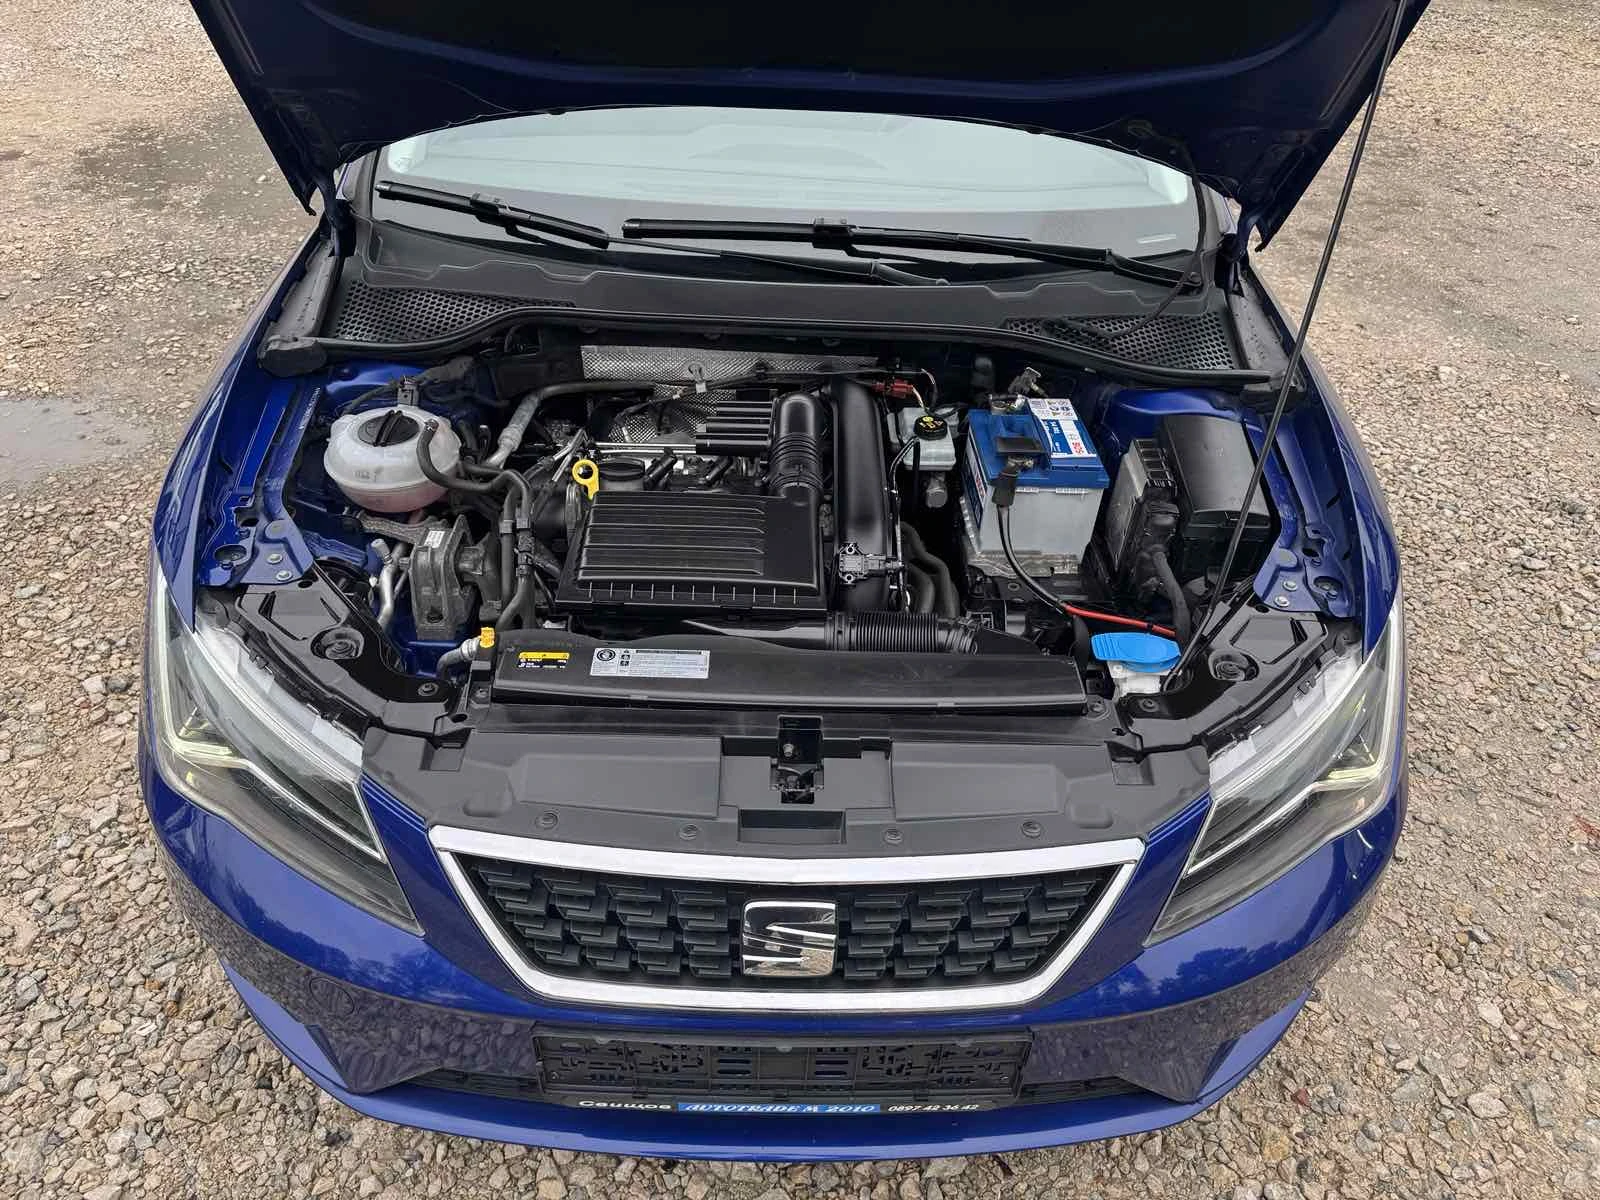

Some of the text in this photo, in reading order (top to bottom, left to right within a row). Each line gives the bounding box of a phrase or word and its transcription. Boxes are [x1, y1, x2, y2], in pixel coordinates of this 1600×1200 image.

[578, 1100, 672, 1110] Свищов
[685, 1103, 801, 1113] AUTOTRADE
[825, 1104, 876, 1113] 2010
[887, 1104, 923, 1112] 0897
[960, 1103, 980, 1111] 42
